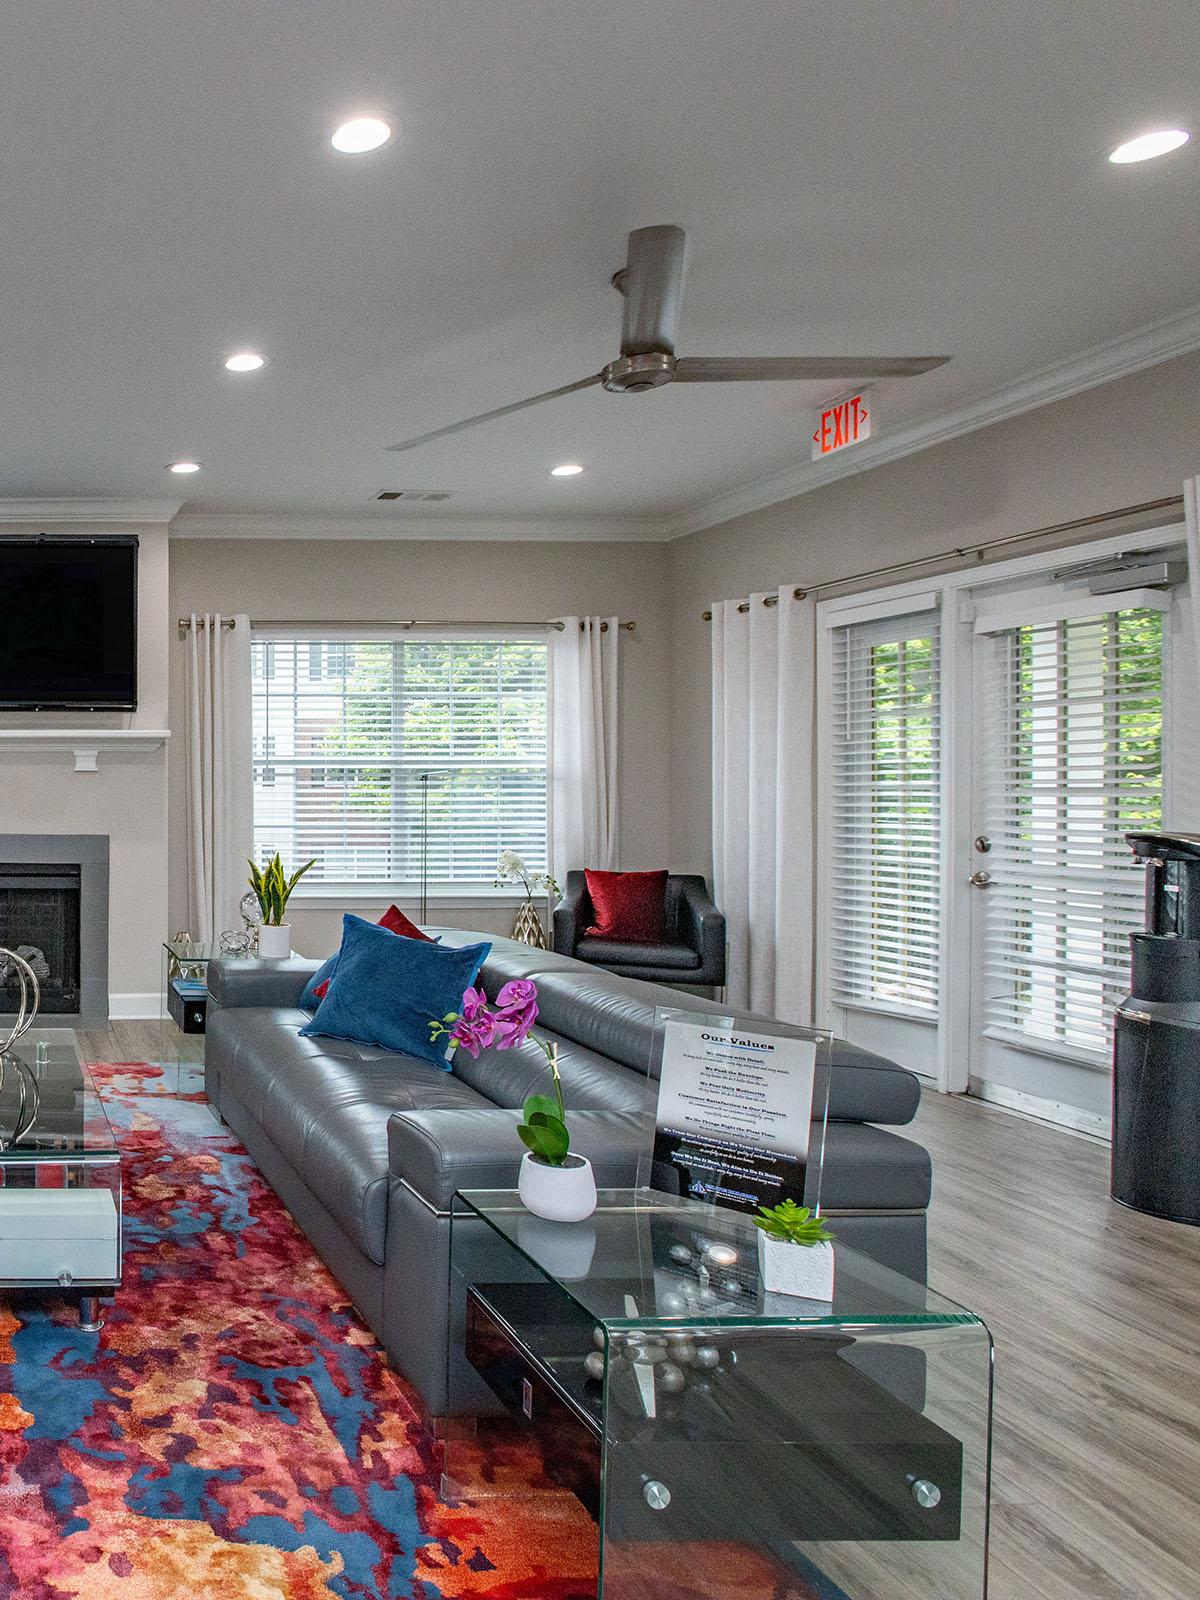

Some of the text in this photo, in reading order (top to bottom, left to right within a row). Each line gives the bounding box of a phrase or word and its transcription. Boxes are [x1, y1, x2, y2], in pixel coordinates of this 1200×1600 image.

[821, 395, 861, 453] EXIT
[701, 1033, 775, 1050] Our Values
[678, 1093, 705, 1101] Customer
[706, 1098, 741, 1108] Satisfaction
[697, 1134, 722, 1144] Company
